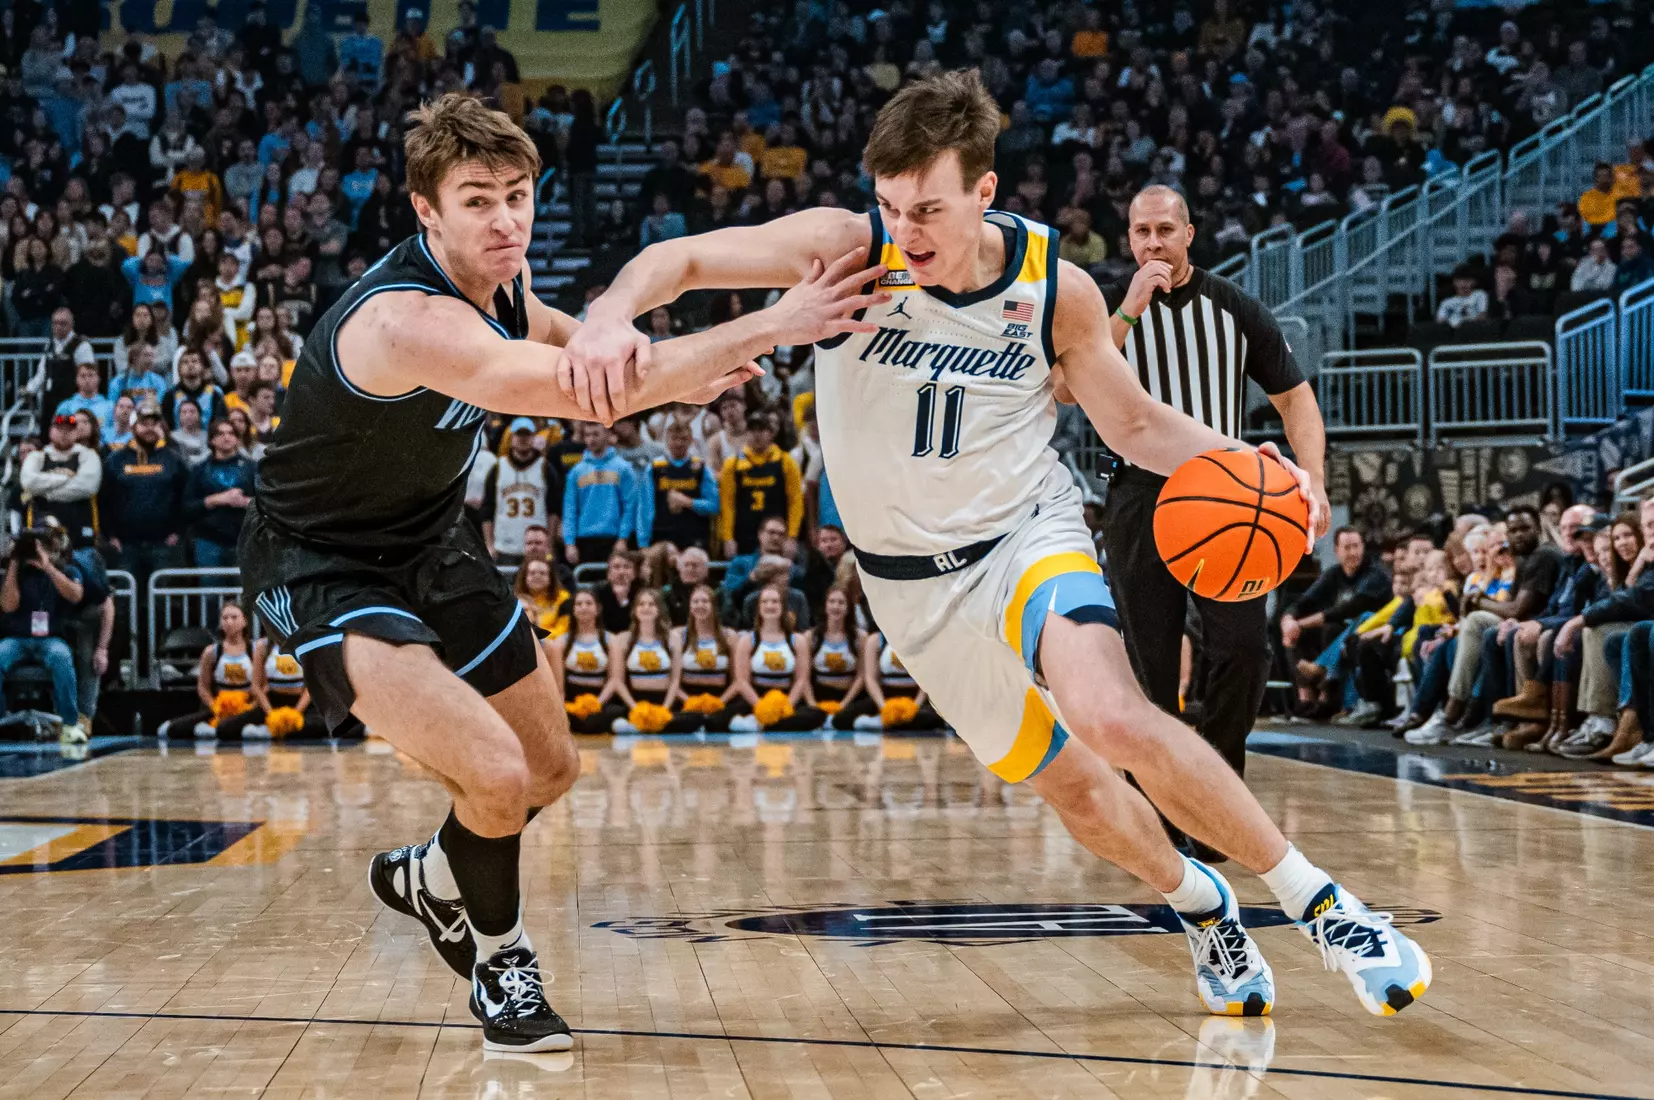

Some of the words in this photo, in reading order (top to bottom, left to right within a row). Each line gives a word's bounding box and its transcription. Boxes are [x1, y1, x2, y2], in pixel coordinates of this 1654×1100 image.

[1002, 329, 1033, 338] EAST
[1006, 322, 1028, 331] BIG
[859, 326, 1036, 381] Marquette
[911, 382, 965, 459] 11
[506, 498, 535, 517] 33
[751, 491, 765, 511] 3
